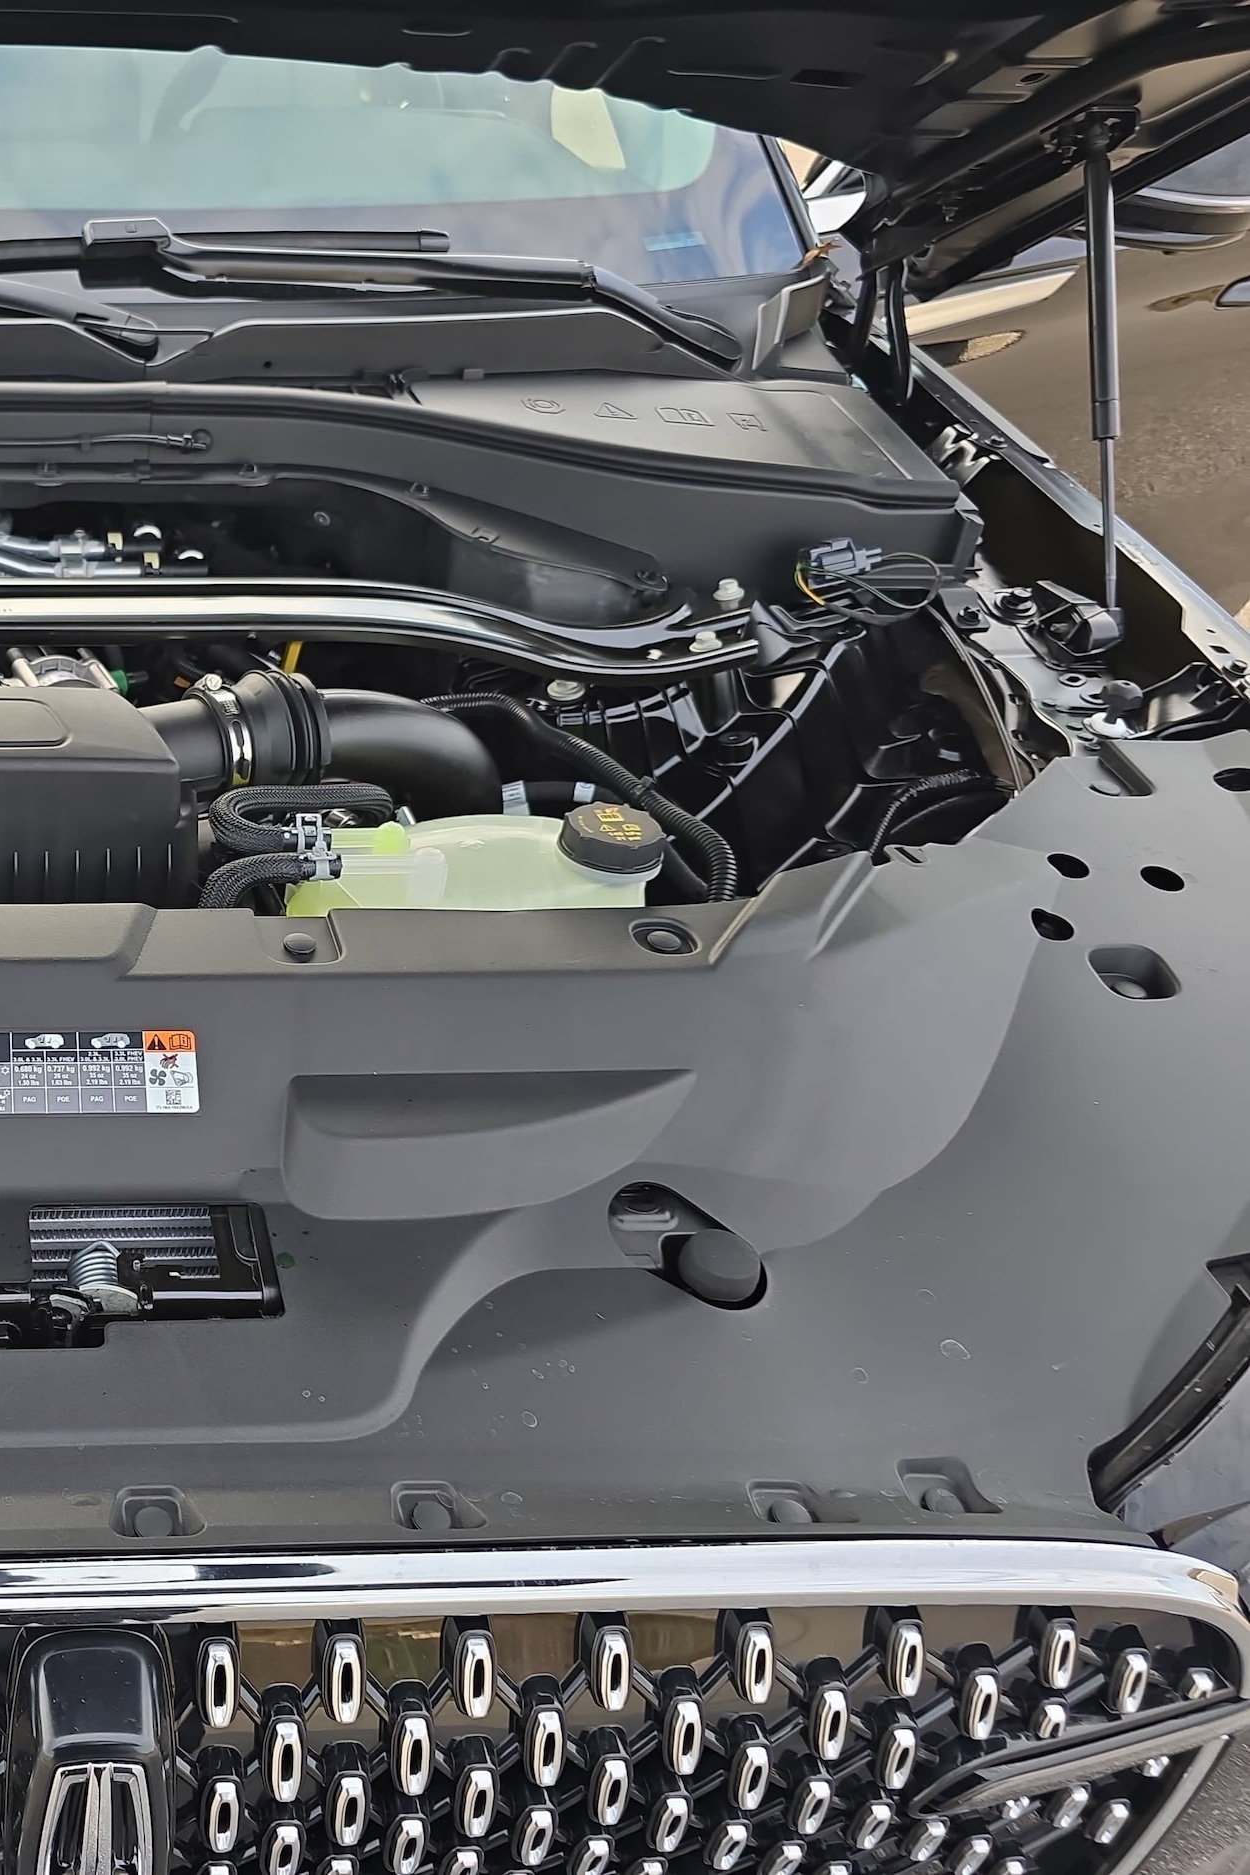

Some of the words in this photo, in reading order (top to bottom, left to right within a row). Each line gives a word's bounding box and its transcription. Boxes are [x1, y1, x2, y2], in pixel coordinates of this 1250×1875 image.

[33, 1065, 43, 1075] kg
[47, 1065, 65, 1073] 0.737
[66, 1065, 75, 1074] kg
[82, 1064, 100, 1072] 0.992
[101, 1064, 110, 1074] kg
[115, 1064, 133, 1072] 0.992
[134, 1064, 143, 1074] kg
